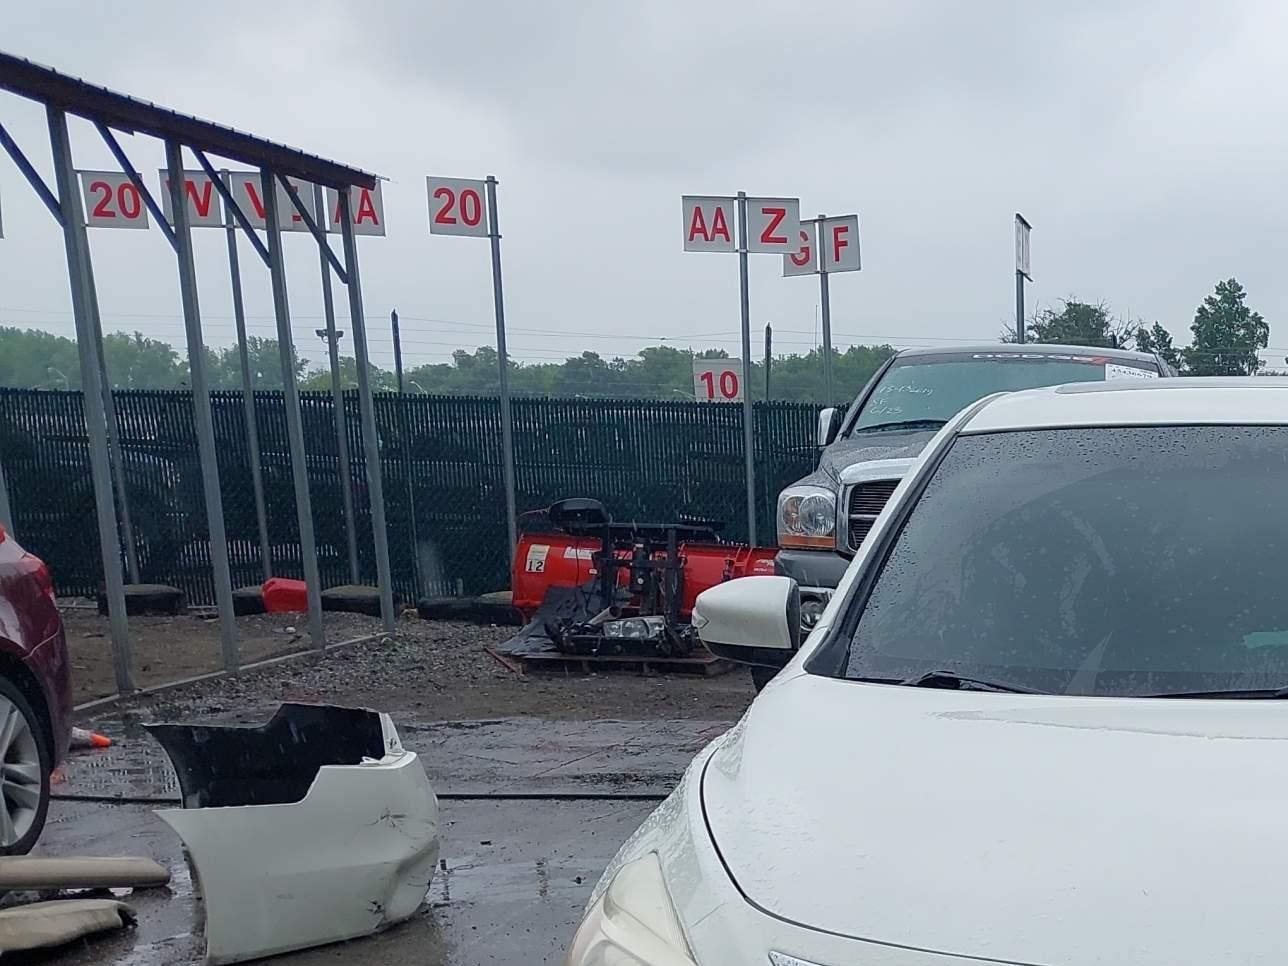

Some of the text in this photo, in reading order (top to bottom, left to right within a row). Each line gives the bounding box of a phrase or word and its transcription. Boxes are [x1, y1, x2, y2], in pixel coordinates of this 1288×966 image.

[93, 182, 142, 218] 20
[435, 187, 481, 224] 20
[688, 206, 730, 242] AA
[759, 208, 788, 244] Z
[791, 231, 810, 267] G
[833, 226, 849, 262] F
[701, 371, 739, 400] 10
[527, 561, 543, 572] 12
